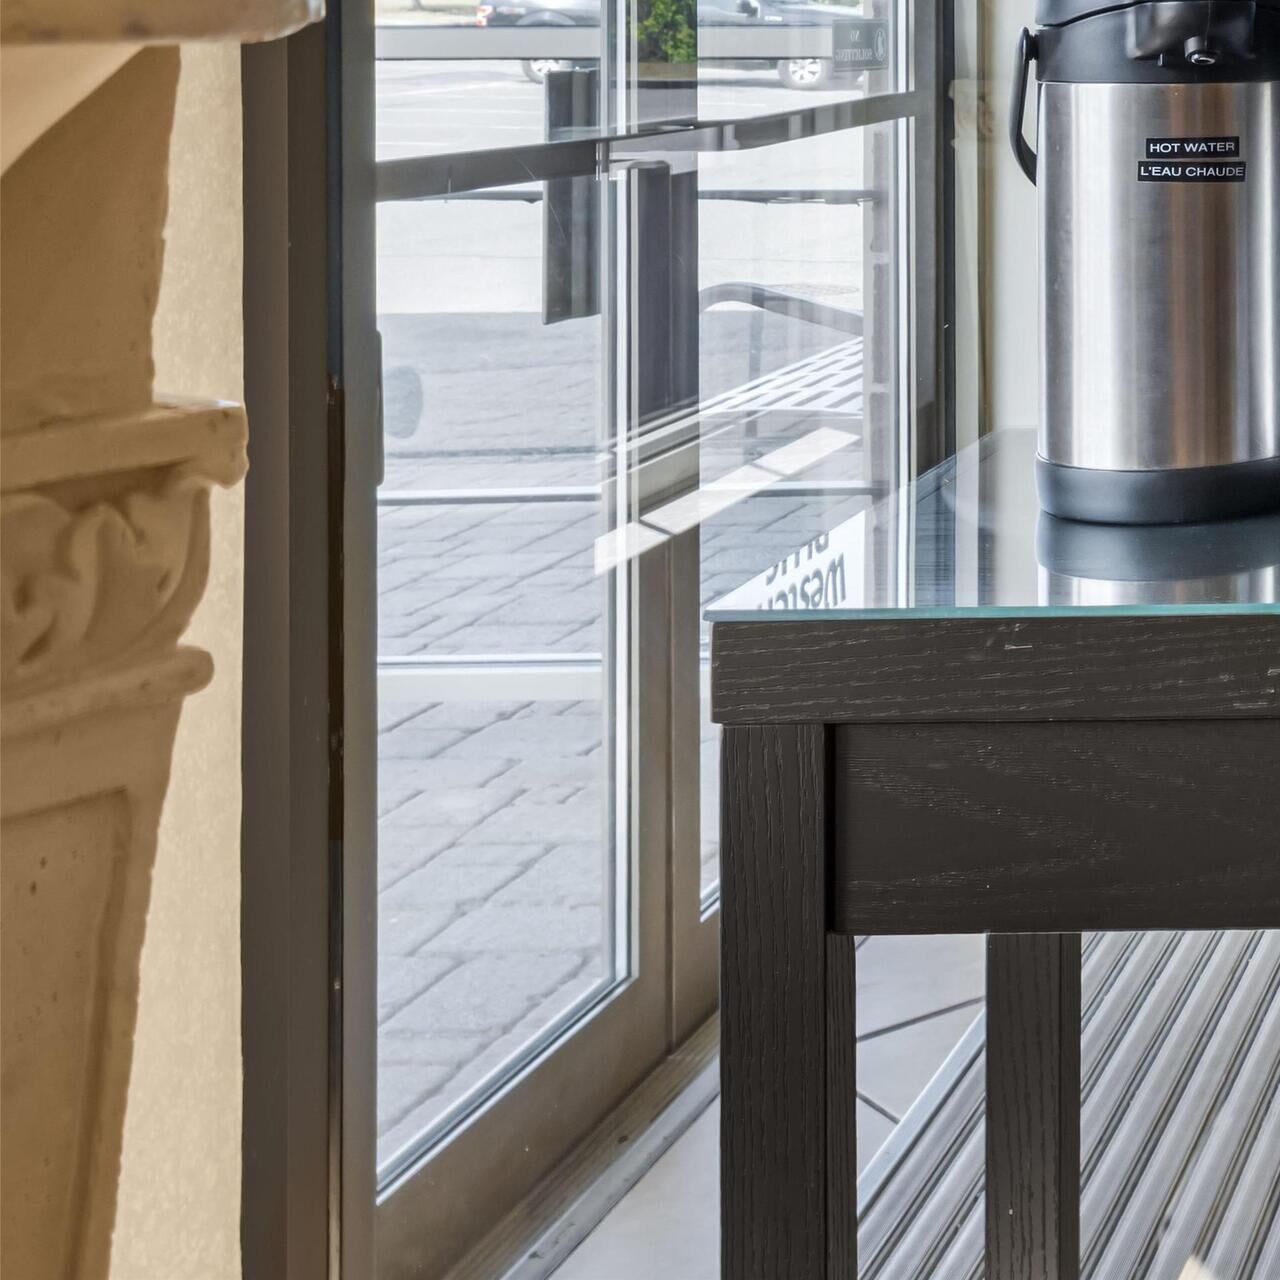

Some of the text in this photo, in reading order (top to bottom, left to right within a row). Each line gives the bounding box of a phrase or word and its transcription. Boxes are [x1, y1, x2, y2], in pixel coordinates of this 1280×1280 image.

[1149, 142, 1235, 153] HOT WATER
[1140, 166, 1245, 177] L'EAU CHAUDE
